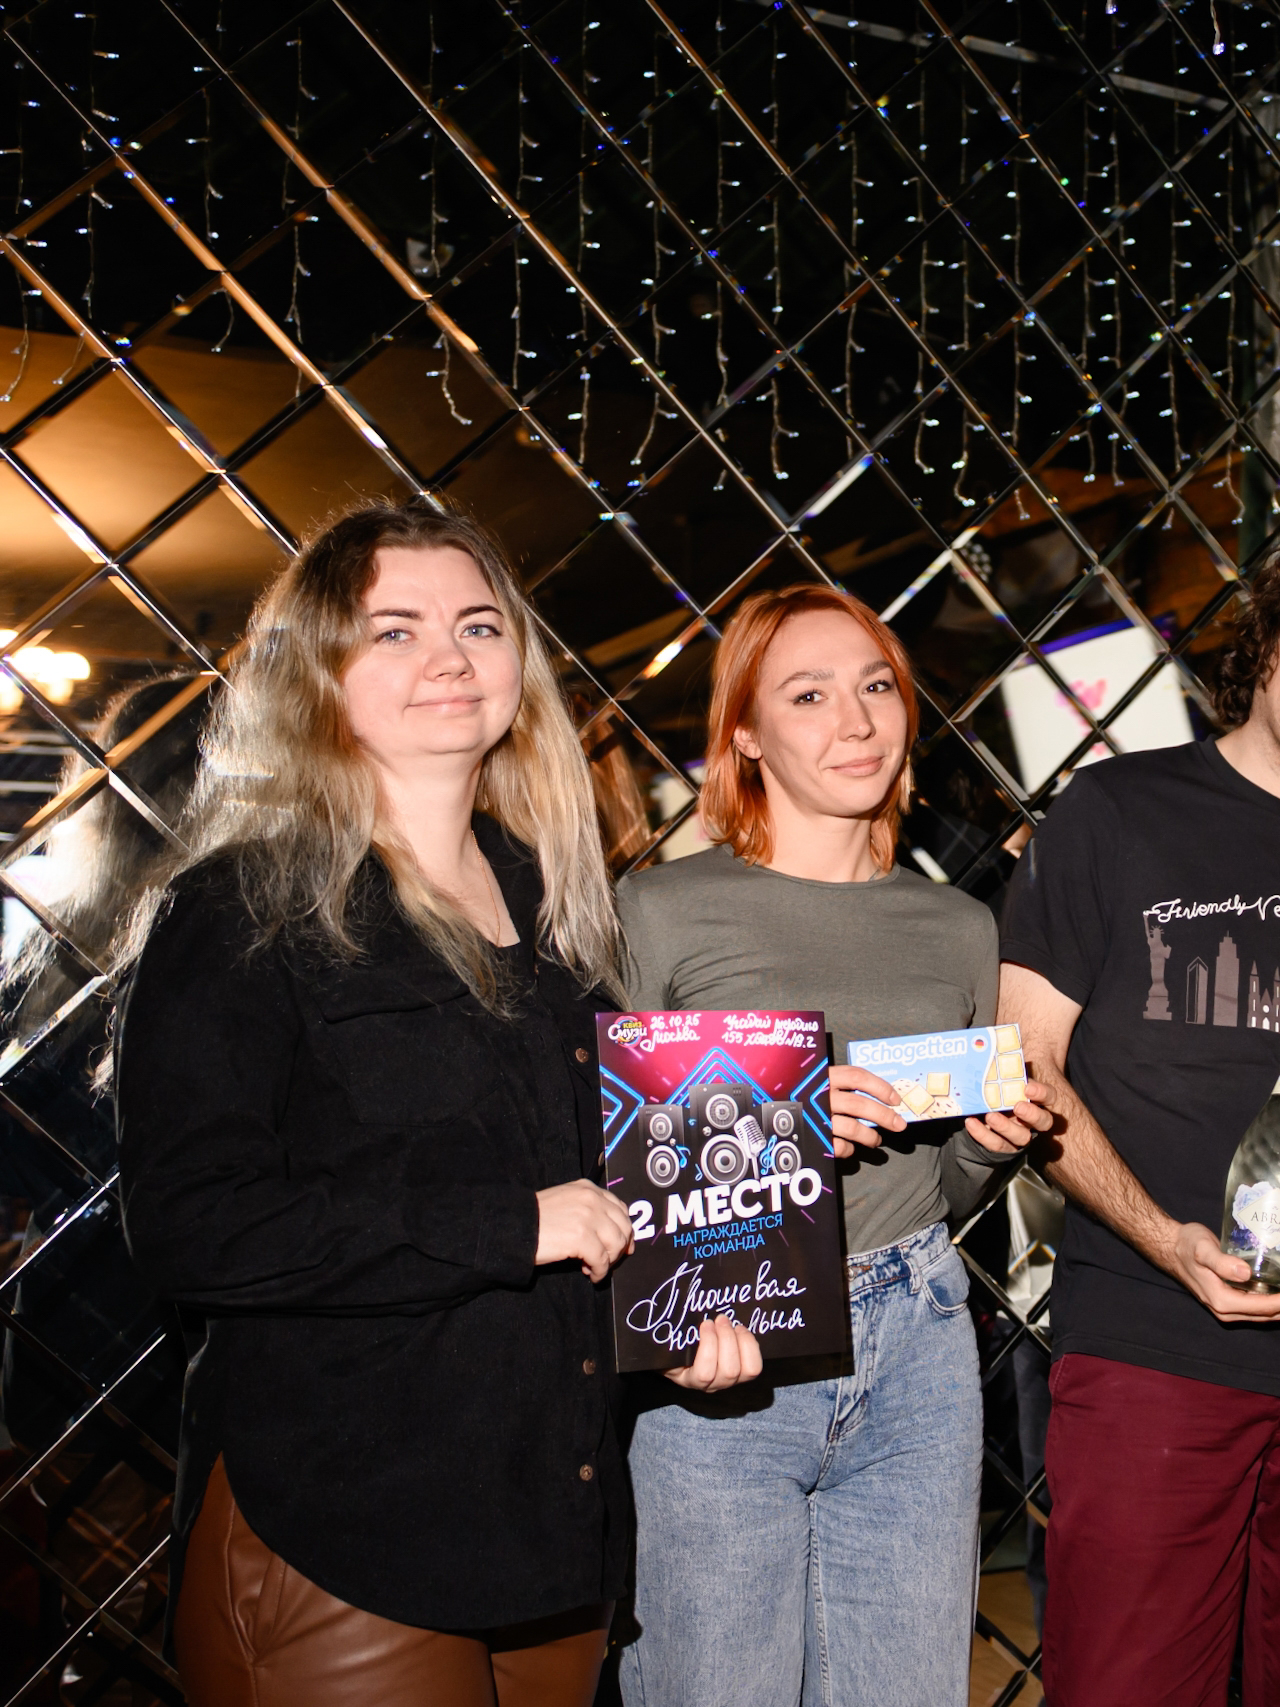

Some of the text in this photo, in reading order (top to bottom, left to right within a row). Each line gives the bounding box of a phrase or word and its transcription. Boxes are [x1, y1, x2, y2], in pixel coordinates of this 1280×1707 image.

[1147, 894, 1247, 923] Friendly
[607, 1023, 648, 1041] Смузи
[623, 1021, 643, 1029] КВИЗ
[857, 1036, 967, 1066] Schogetten
[629, 1167, 823, 1241] 2 МЕСТО
[673, 1213, 783, 1248] НАГРАЖДАЕТСЯ
[693, 1233, 765, 1259] КОМАНДА
[626, 1260, 807, 1340] Плюшевая
